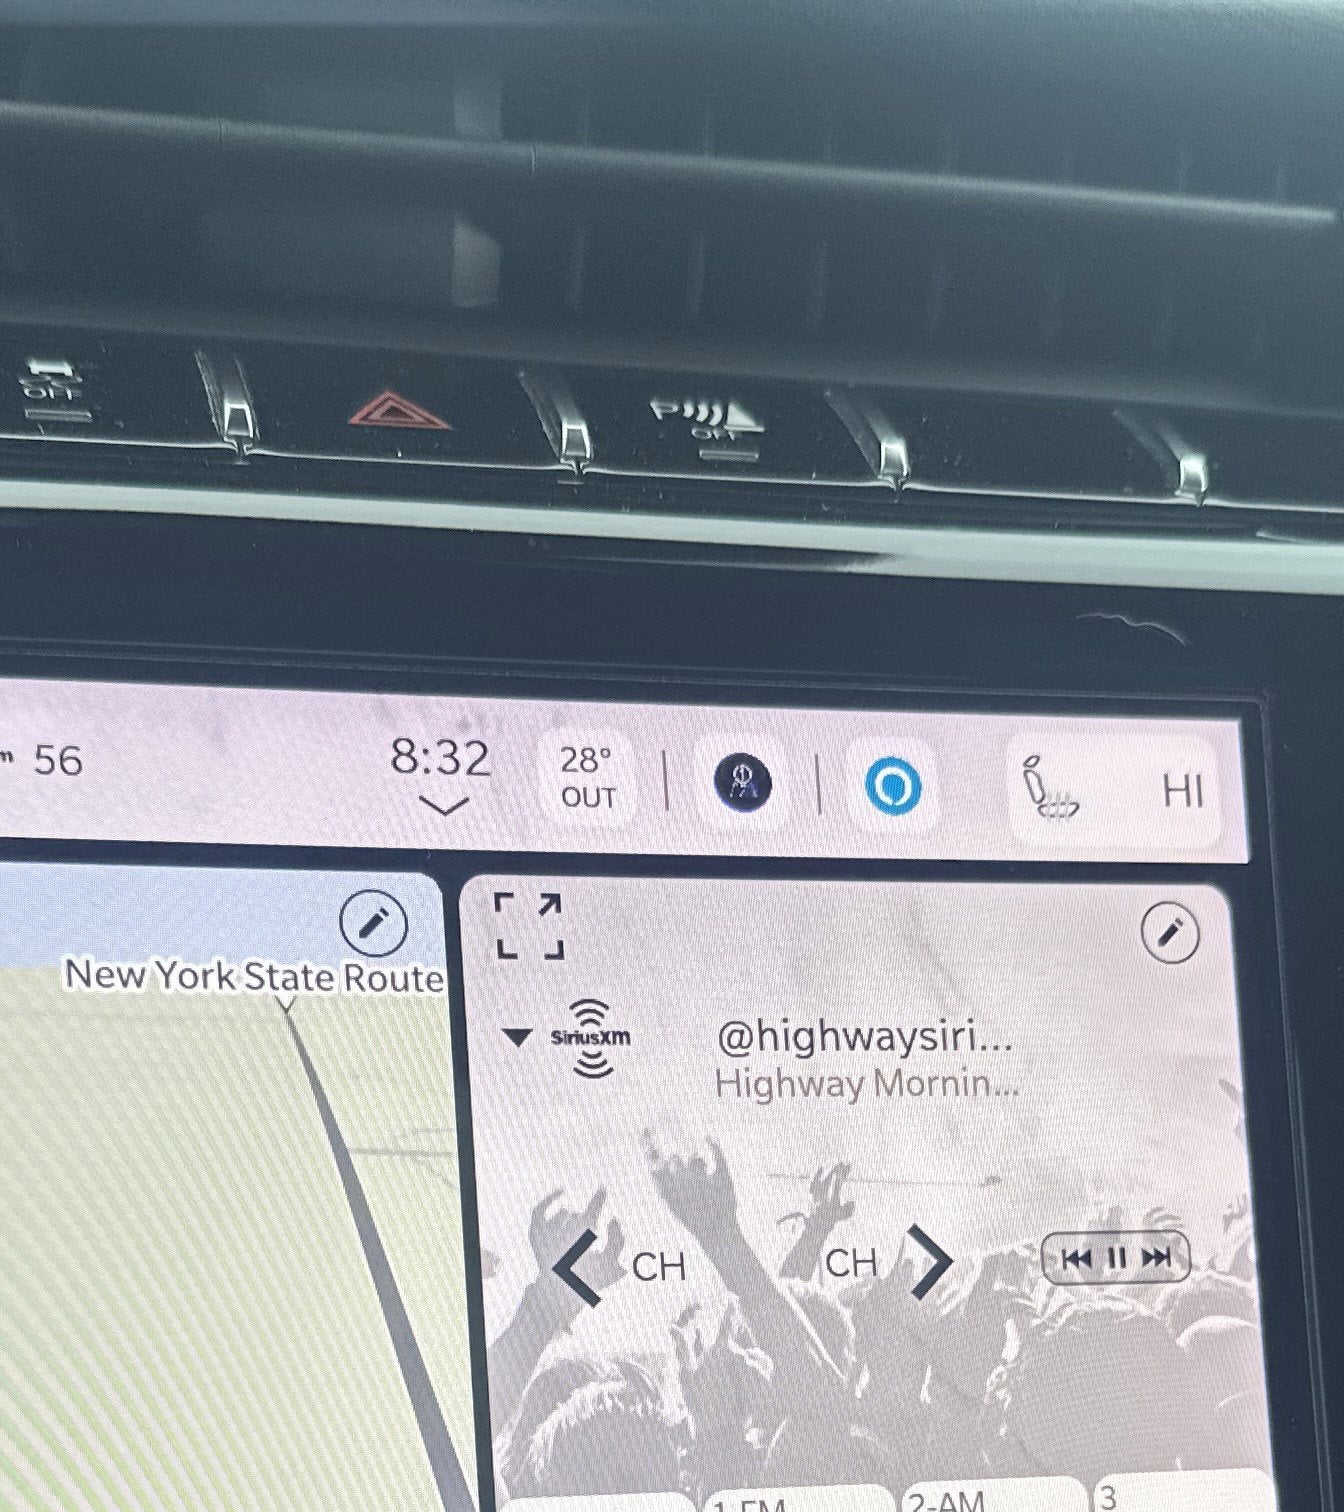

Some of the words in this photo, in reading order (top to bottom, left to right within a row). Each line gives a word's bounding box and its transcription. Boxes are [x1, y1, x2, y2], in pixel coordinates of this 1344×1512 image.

[34, 743, 84, 778] 56
[390, 736, 493, 779] 8:32
[559, 745, 613, 775] 28°
[561, 786, 617, 809] OUT
[1162, 772, 1204, 809] HI
[65, 958, 147, 990] New
[156, 958, 237, 991] York
[244, 961, 337, 993] State
[345, 963, 446, 994] Route
[717, 1018, 1014, 1059] @highwaysiri...
[715, 1067, 866, 1104] Highway
[874, 1066, 1020, 1099] Mornin...
[632, 1250, 687, 1282] CH
[825, 1246, 879, 1278] CH
[1099, 1485, 1117, 1512] 3
